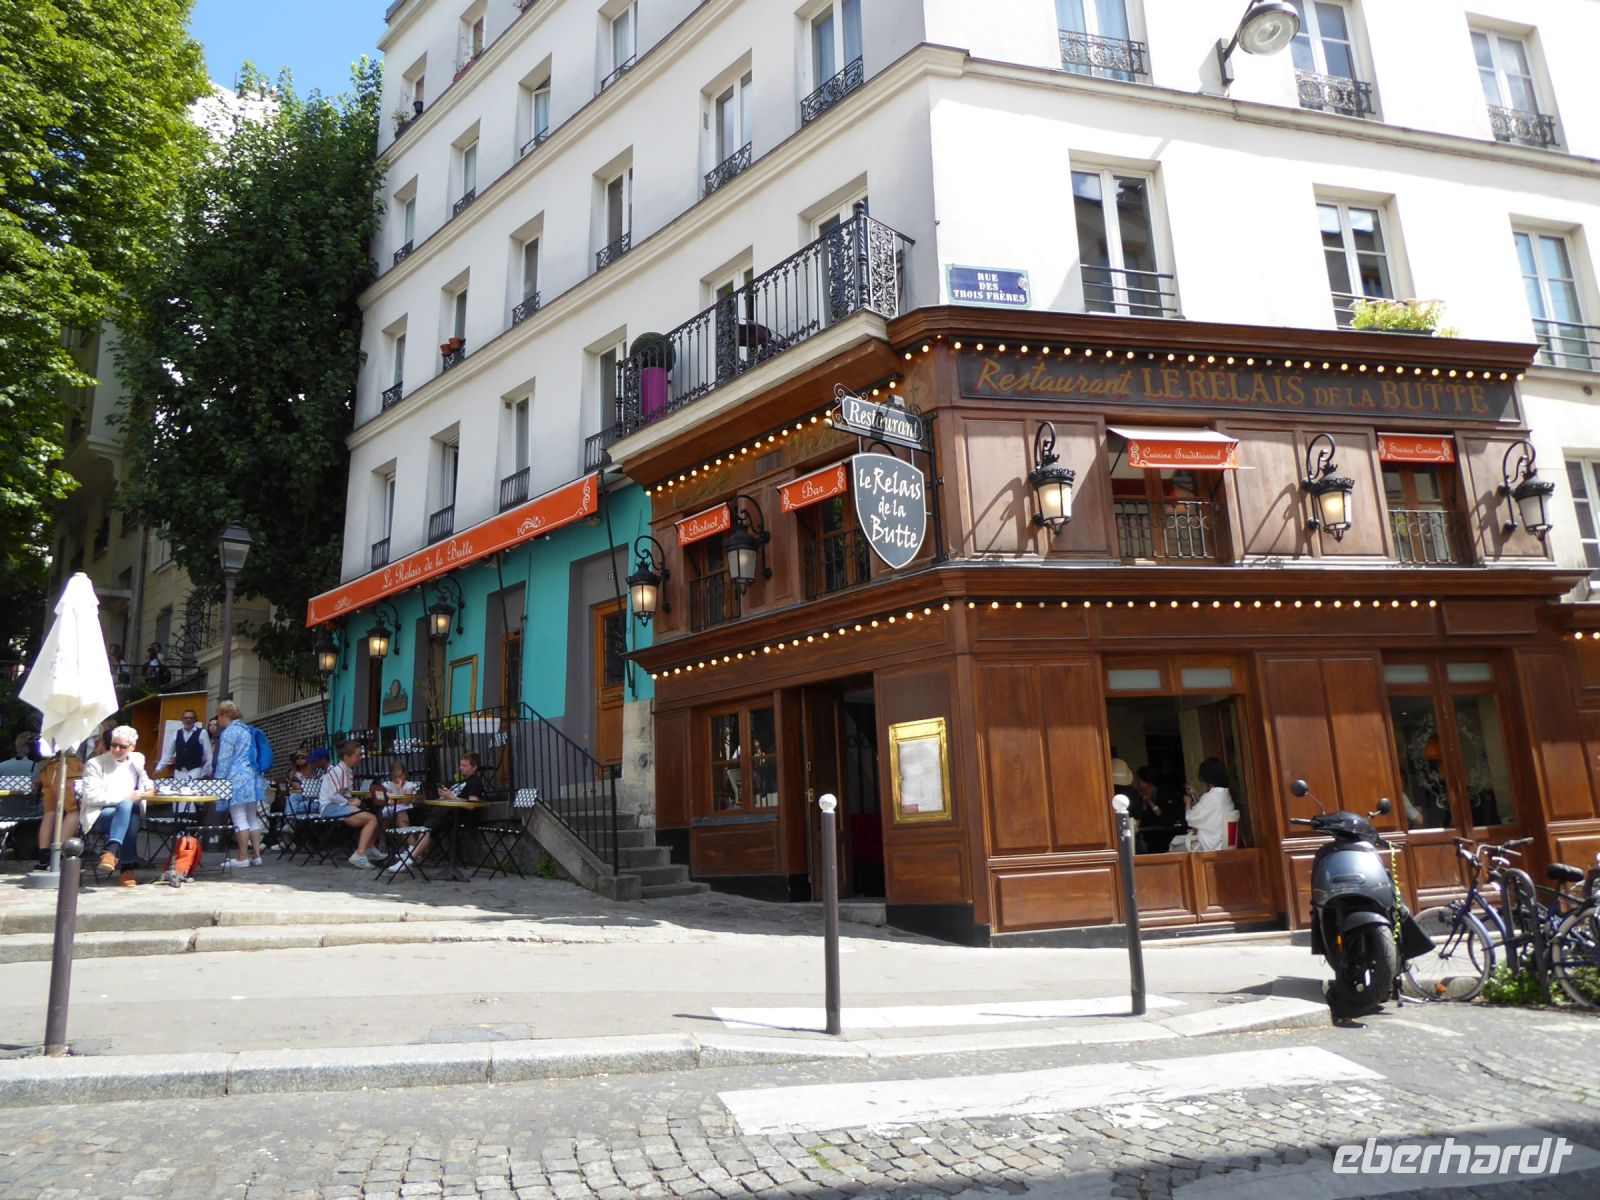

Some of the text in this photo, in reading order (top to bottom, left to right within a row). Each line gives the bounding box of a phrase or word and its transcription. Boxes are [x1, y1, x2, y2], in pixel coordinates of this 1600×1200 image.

[977, 272, 999, 282] RUE
[979, 282, 999, 291] DES
[953, 289, 1026, 303] TROIS FRÈRES
[976, 357, 1489, 414] Restaurant LE RELAIS DE LA BUTTE
[849, 400, 919, 439] Restaurant
[1142, 447, 1221, 460] Cuisine Traditionnel
[802, 480, 824, 498] Bar
[872, 467, 921, 500] Relais
[878, 495, 907, 520] de la
[689, 515, 719, 537] Bistrot
[870, 514, 918, 548] Butte
[383, 540, 473, 589] Le Relais de la Butte
